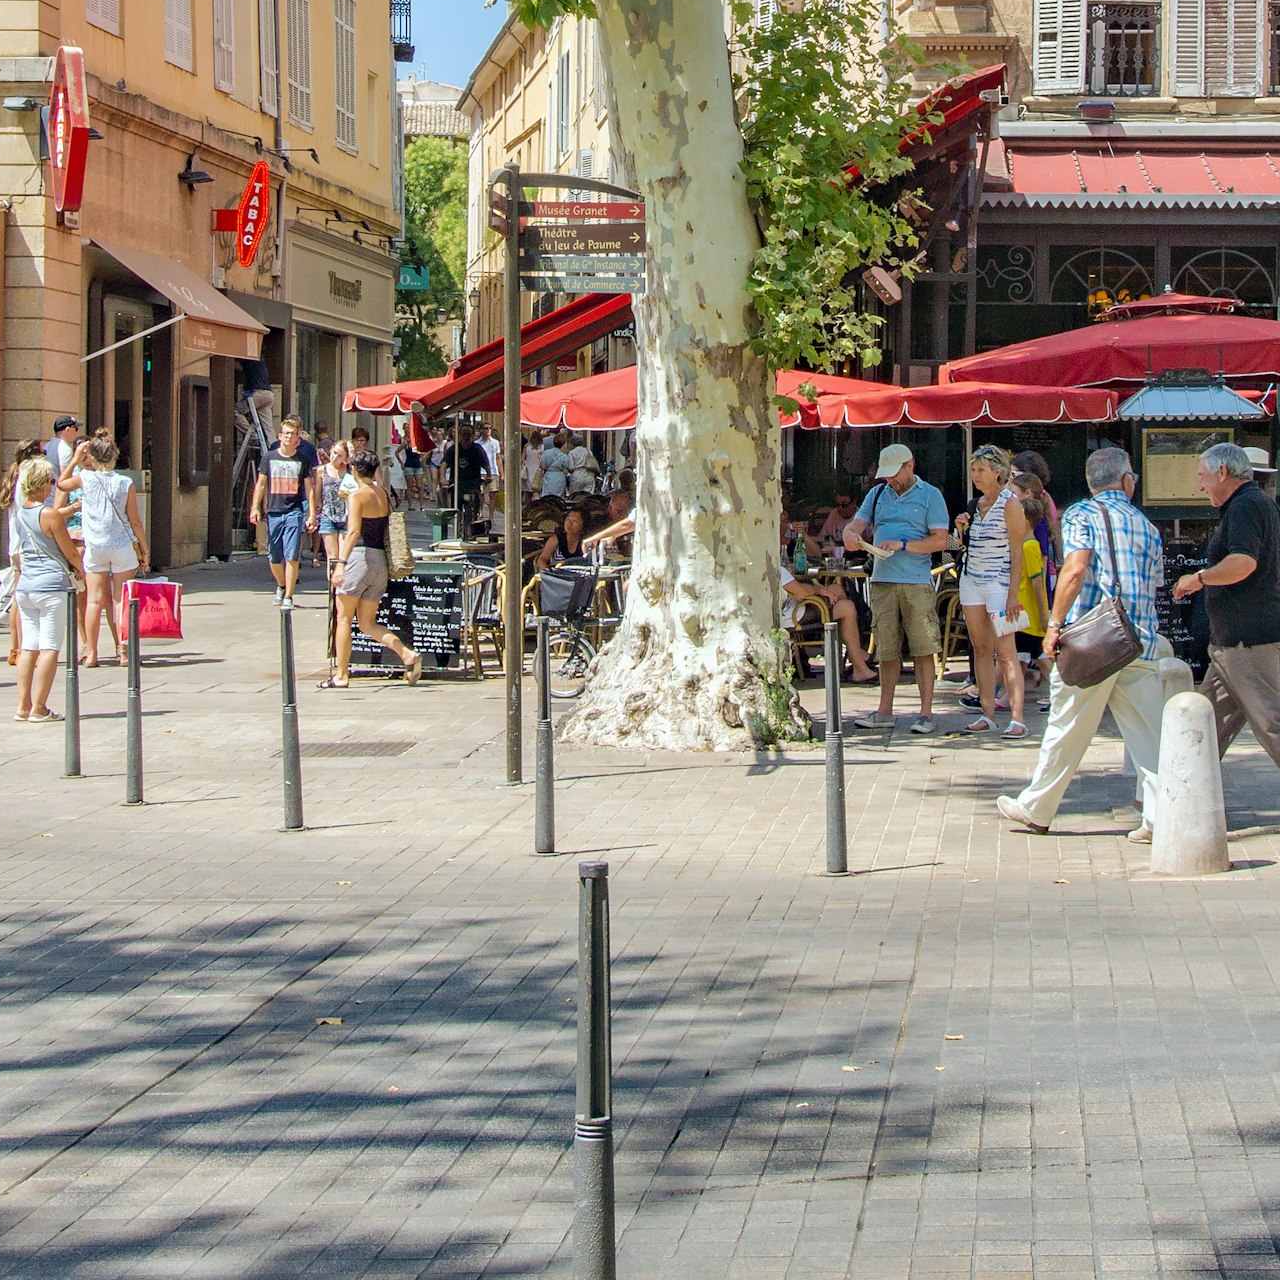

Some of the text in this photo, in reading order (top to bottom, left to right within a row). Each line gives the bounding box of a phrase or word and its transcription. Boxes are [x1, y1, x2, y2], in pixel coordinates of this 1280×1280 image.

[56, 92, 65, 169] TABAC
[243, 182, 263, 246] TABAC
[538, 205, 607, 216] Musée Granet
[538, 227, 577, 238] Théâtre
[538, 239, 621, 252] du Jeu de Paume
[539, 259, 569, 269] Tribunal
[570, 259, 579, 269] de
[594, 259, 627, 269] Instance
[538, 279, 625, 290] Tribunal de Commerce
